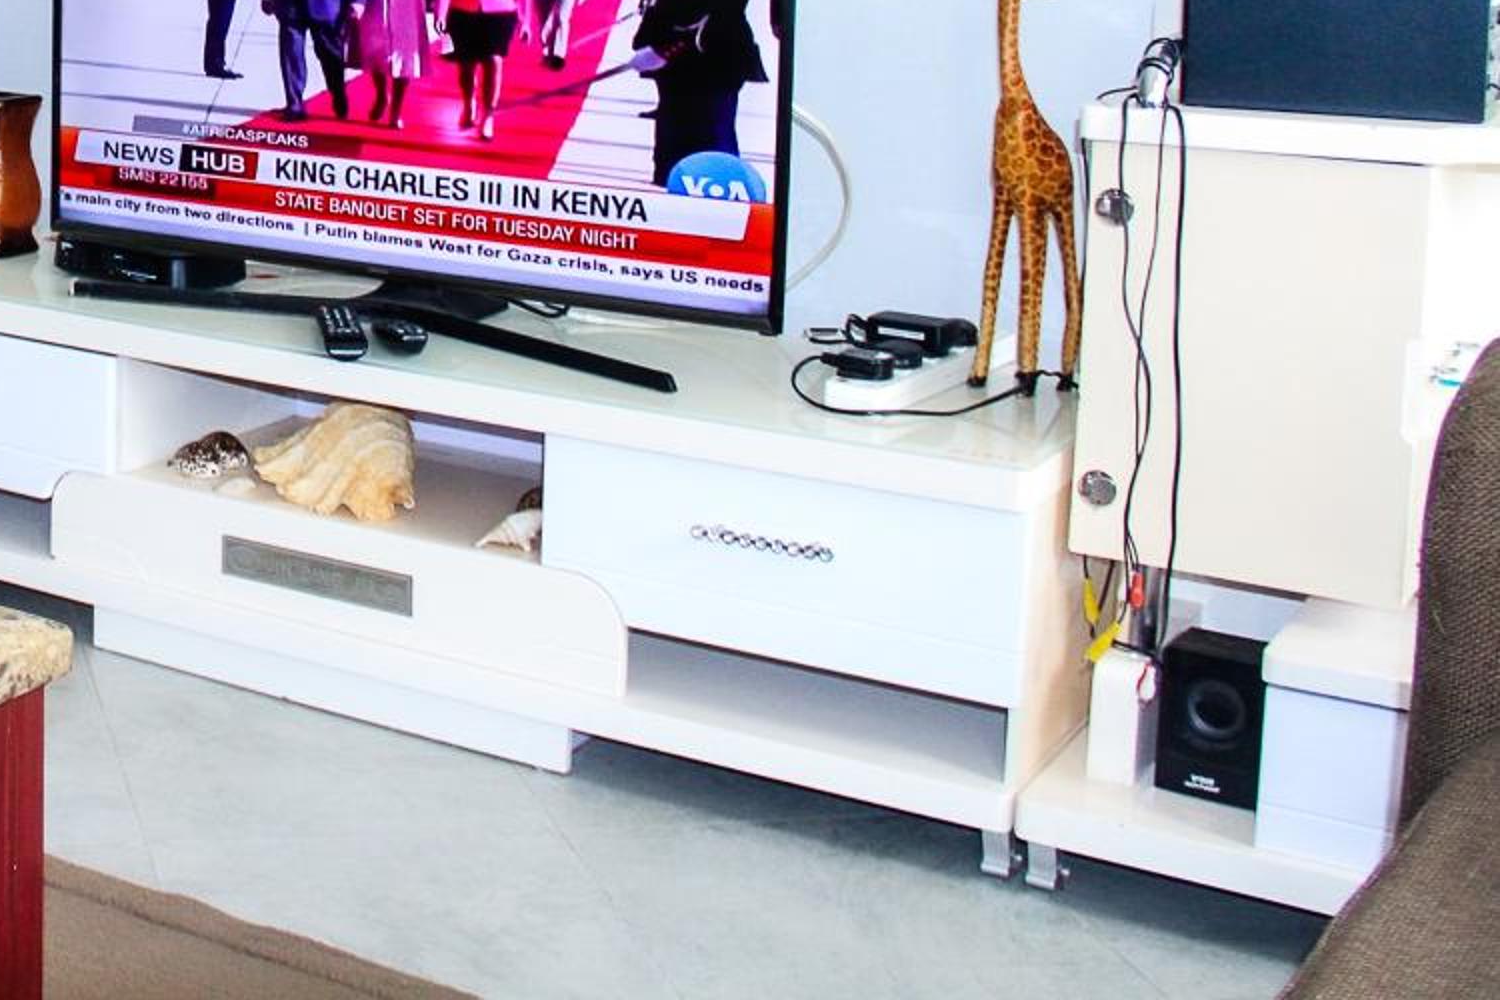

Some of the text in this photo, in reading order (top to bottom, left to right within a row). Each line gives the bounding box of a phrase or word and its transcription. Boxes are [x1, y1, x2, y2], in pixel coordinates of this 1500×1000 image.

[103, 140, 245, 173] NEWS HUB
[182, 124, 308, 148] #AFRICASPEAKS
[118, 167, 155, 184] SMS
[275, 157, 648, 222] KING CHARLES III IN KENYA
[76, 194, 110, 206] main
[115, 198, 140, 213] city
[145, 201, 180, 216] from
[183, 205, 211, 220] two
[216, 209, 295, 231] directions
[315, 223, 357, 240] Putin
[363, 228, 423, 249] blames
[429, 238, 472, 255] West
[477, 244, 501, 259] for
[507, 247, 552, 265] Gaza
[557, 254, 614, 275] crisis,
[620, 264, 664, 281] says
[670, 269, 698, 284] US
[704, 274, 764, 293] needs
[275, 191, 638, 250] STATE BANQUET SET FOR TUESDAY NIGHT
